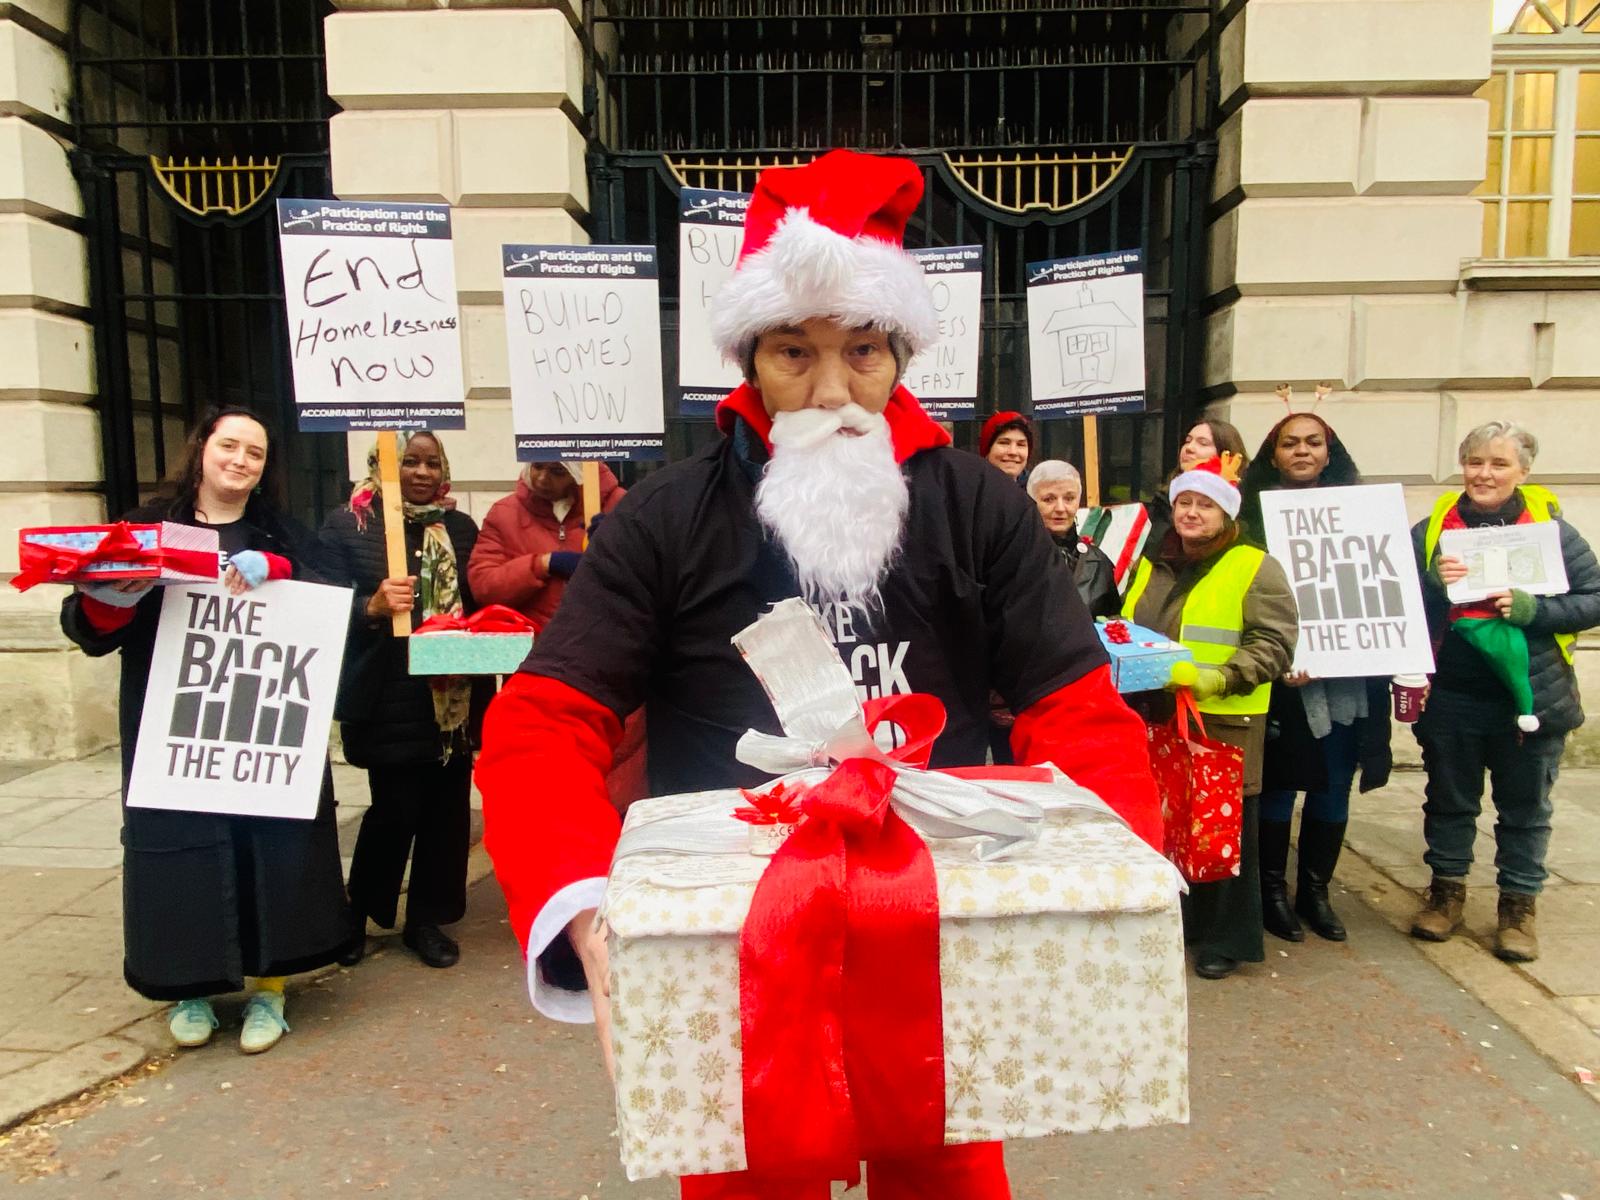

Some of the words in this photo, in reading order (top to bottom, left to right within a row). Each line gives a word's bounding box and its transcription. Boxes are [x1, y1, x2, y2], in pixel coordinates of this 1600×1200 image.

[321, 206, 398, 221] Participation
[400, 210, 424, 221] and
[426, 210, 447, 221] the
[322, 220, 372, 232] Practice
[374, 222, 387, 232] of
[389, 222, 427, 235] Rights
[539, 250, 609, 263] Participation
[611, 251, 632, 262] and
[635, 252, 653, 262] the
[926, 263, 936, 271] of
[937, 262, 965, 271] Rights
[946, 251, 963, 260] and
[964, 251, 980, 259] the
[1053, 259, 1105, 272] Participation
[1106, 255, 1122, 264] and
[1124, 254, 1138, 262] the
[303, 238, 446, 307] End
[540, 263, 585, 273] Practice
[586, 263, 599, 273] of
[600, 264, 636, 276] Rights
[1054, 270, 1086, 280] Practice
[1088, 268, 1096, 276] of
[1098, 265, 1125, 275] Rights
[520, 289, 623, 335] BUILD
[296, 312, 457, 358] Homelessness
[532, 334, 632, 376] HOMES
[937, 345, 956, 368] IN
[909, 372, 965, 391] LFAST
[301, 408, 366, 417] ACCOUNTABILITY
[371, 408, 405, 417] EQUALITY
[410, 408, 463, 416] PARTICIPATION
[553, 382, 628, 424] NOW
[518, 440, 576, 448] ACCOUNTABILITY
[580, 440, 610, 448] EQUALITY
[1280, 506, 1343, 536] TAKE
[1289, 534, 1399, 583] BACK
[186, 592, 267, 637] TAKE
[1302, 624, 1350, 652] THE
[1356, 621, 1407, 650] CITY
[177, 632, 320, 701] BACK
[850, 641, 912, 698] CK
[166, 742, 225, 780] THE
[232, 749, 301, 786] CITY
